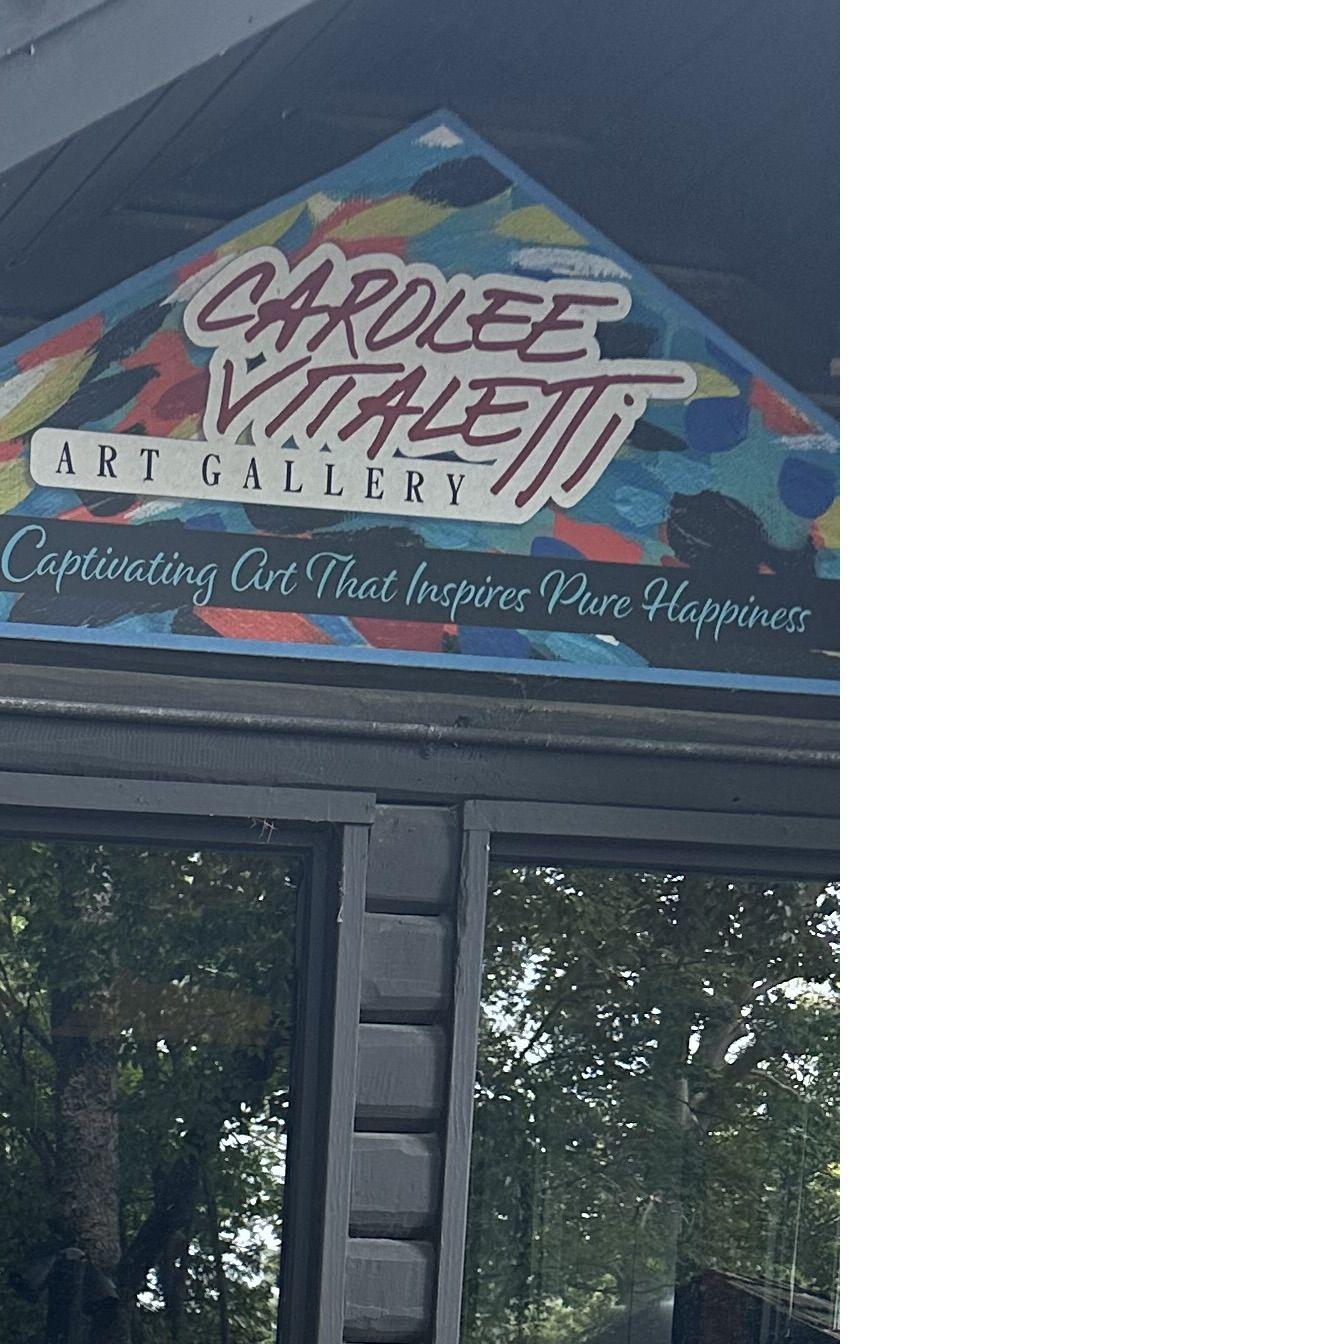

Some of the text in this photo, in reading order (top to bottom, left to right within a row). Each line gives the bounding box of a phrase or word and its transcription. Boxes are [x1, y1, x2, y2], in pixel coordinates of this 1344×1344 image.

[197, 258, 619, 362] CAROLEE
[55, 441, 466, 506] ART GALLERY
[0, 523, 812, 641] Captivating Art That Inspires Pure Happiness
